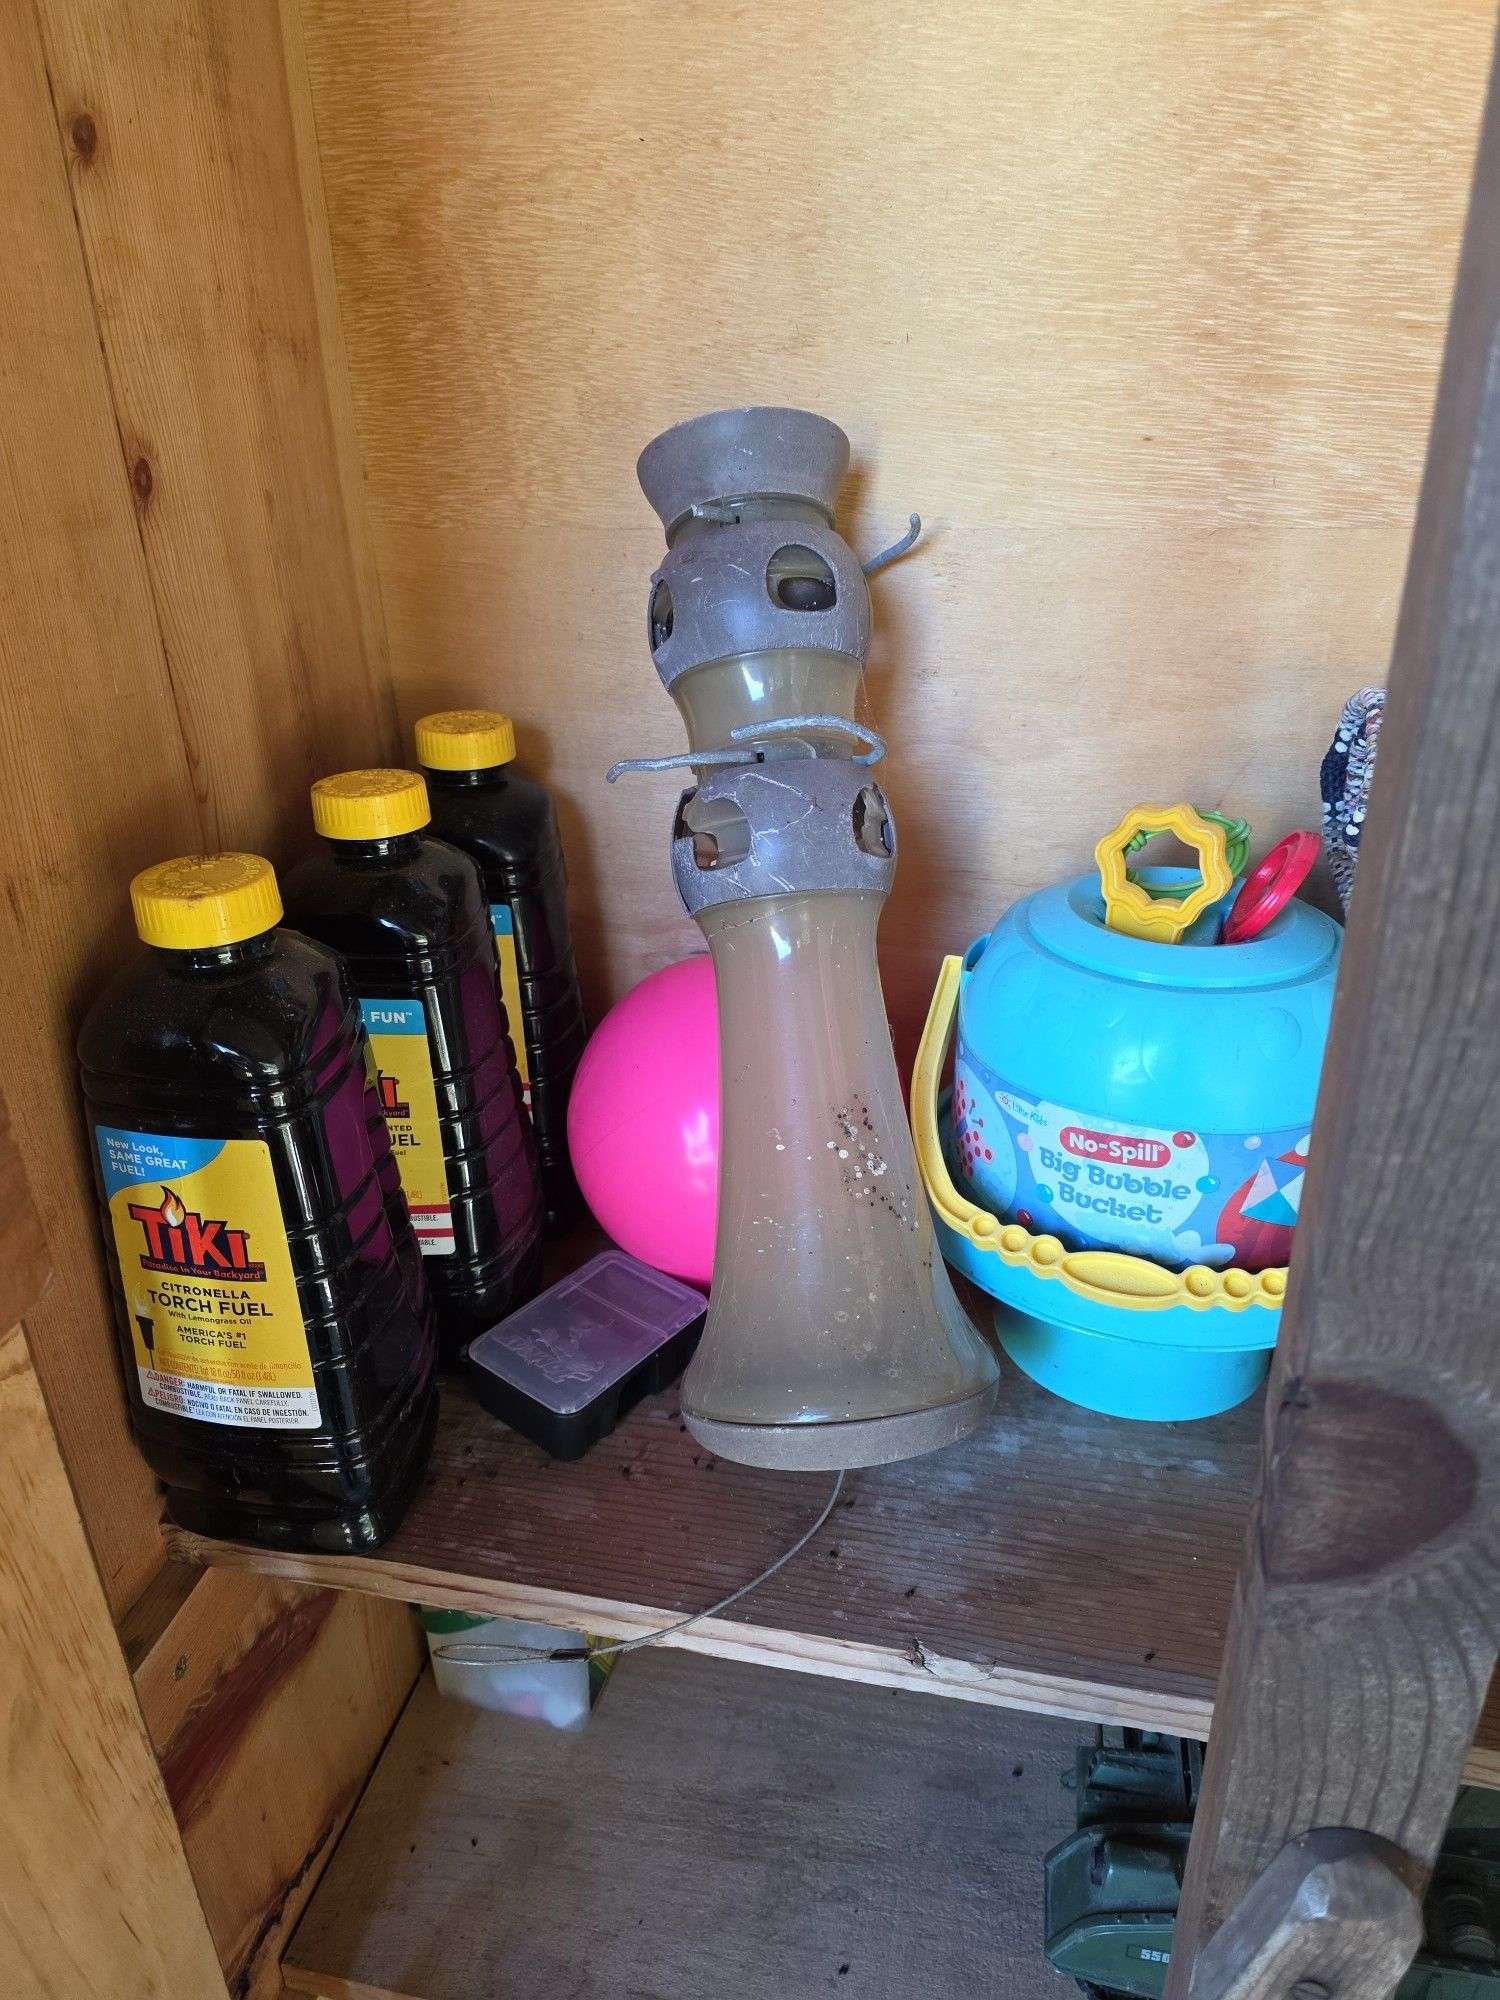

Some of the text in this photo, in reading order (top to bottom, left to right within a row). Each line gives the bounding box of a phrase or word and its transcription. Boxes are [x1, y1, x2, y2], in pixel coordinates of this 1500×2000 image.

[106, 1137, 163, 1156] New Look,
[1069, 1132, 1159, 1163] No-Spill
[109, 1149, 188, 1170] SAME GREAT
[111, 1161, 145, 1177] FUEL!
[1039, 1146, 1191, 1200] Big Bubble
[1058, 1181, 1164, 1224] Bucket
[213, 1269, 261, 1280] Backyard
[161, 1281, 251, 1299] CITRONELLA
[147, 1289, 273, 1317] TORCH FUEL
[167, 1309, 186, 1319] With
[188, 1313, 237, 1325] Lemongrass
[177, 1325, 246, 1340] AMERICA'S #1
[179, 1334, 247, 1349] TORCH FUEL
[186, 1382, 216, 1394] HARMFUL
[228, 1388, 247, 1397] FATAL
[257, 1391, 303, 1399] SWALLOWED.
[215, 1404, 234, 1413] FATAL
[234, 1406, 243, 1414] EN
[244, 1407, 261, 1416] CASO
[262, 1408, 270, 1416] DE
